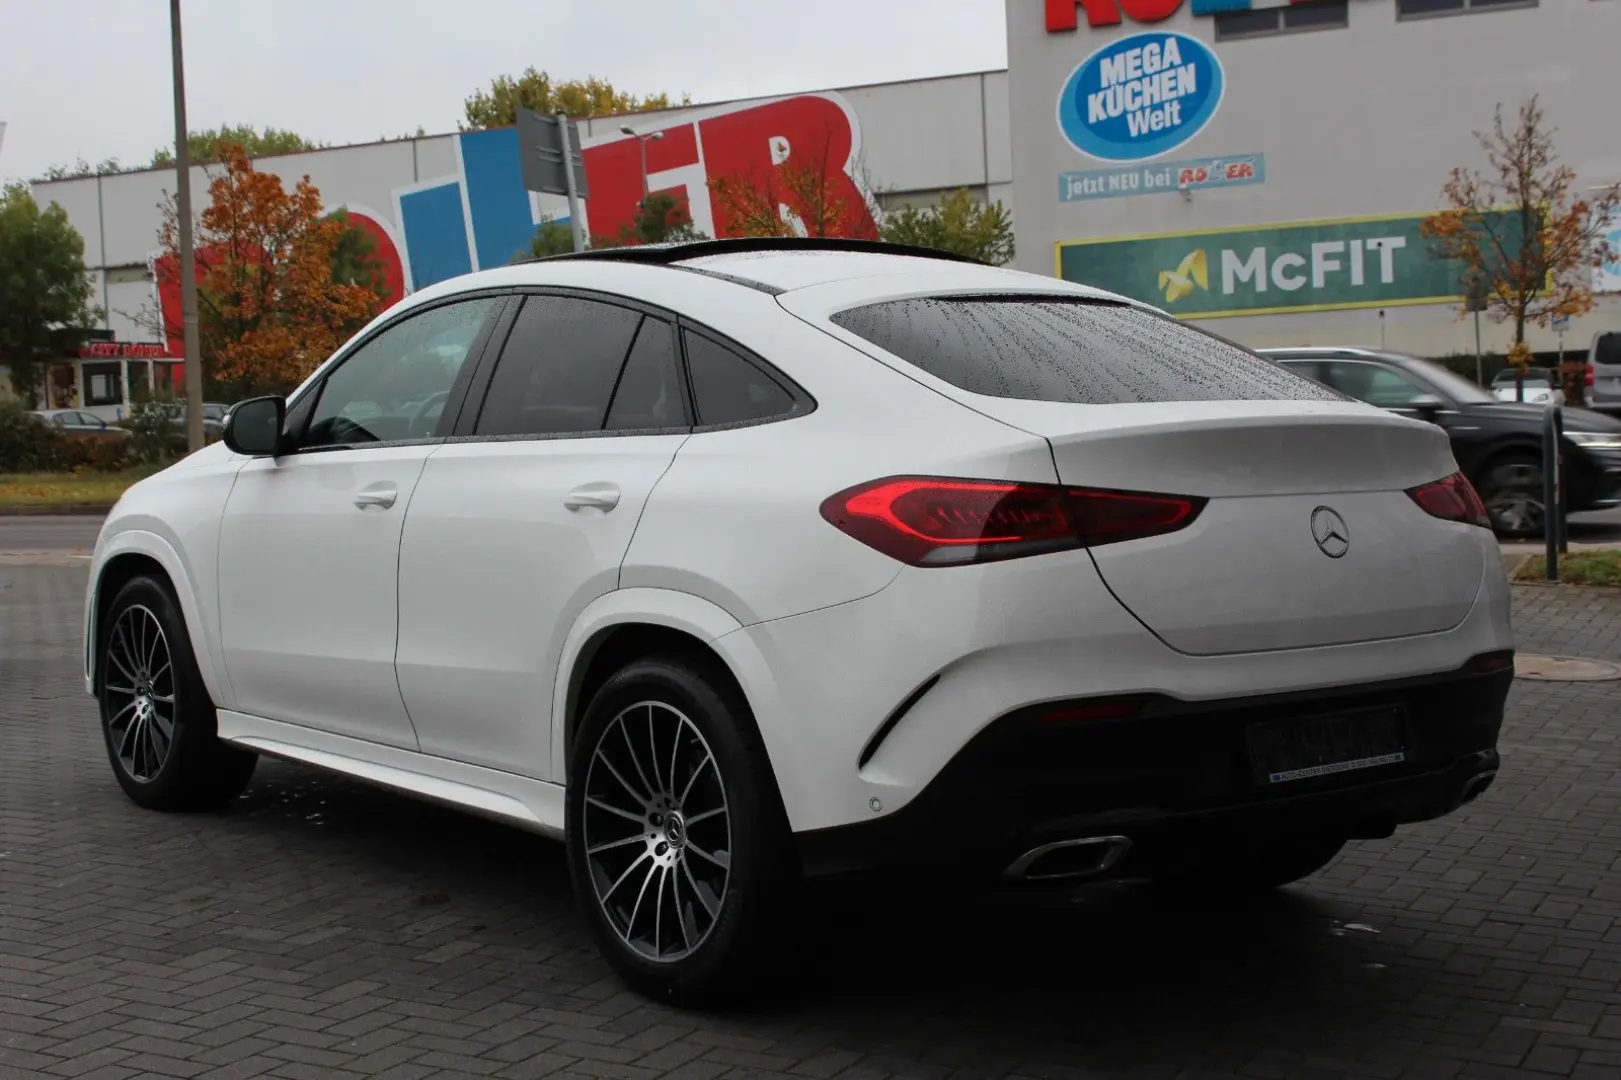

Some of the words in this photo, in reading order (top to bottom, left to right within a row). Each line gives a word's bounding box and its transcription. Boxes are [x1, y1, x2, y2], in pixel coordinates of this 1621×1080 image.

[1099, 36, 1182, 88] MEGA
[1087, 62, 1197, 124] KÜCHEN
[1127, 99, 1182, 138] Welt
[1066, 176, 1105, 199] jetzt
[1108, 170, 1139, 189] NEU
[1144, 168, 1171, 188] bei
[1221, 236, 1407, 295] McFIT
